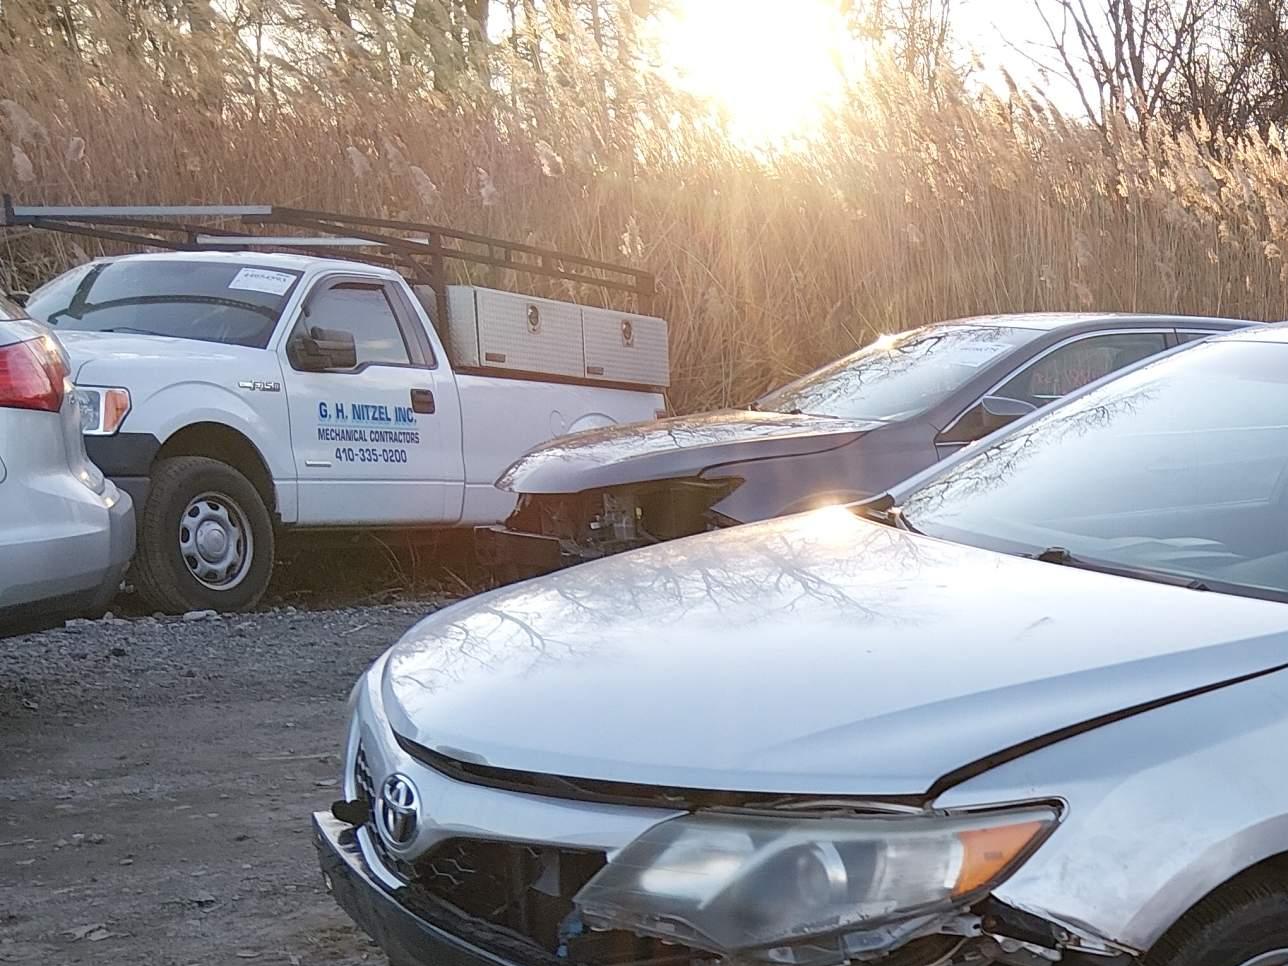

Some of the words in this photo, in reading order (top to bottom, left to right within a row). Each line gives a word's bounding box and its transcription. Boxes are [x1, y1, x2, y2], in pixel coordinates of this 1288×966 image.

[335, 402, 349, 420] H.
[351, 403, 392, 422] NITZEL
[394, 406, 417, 424] INC.
[317, 428, 368, 442] MECHANICAL
[369, 430, 420, 444] CONTRACTORS
[335, 447, 408, 464] 410-335-0200
